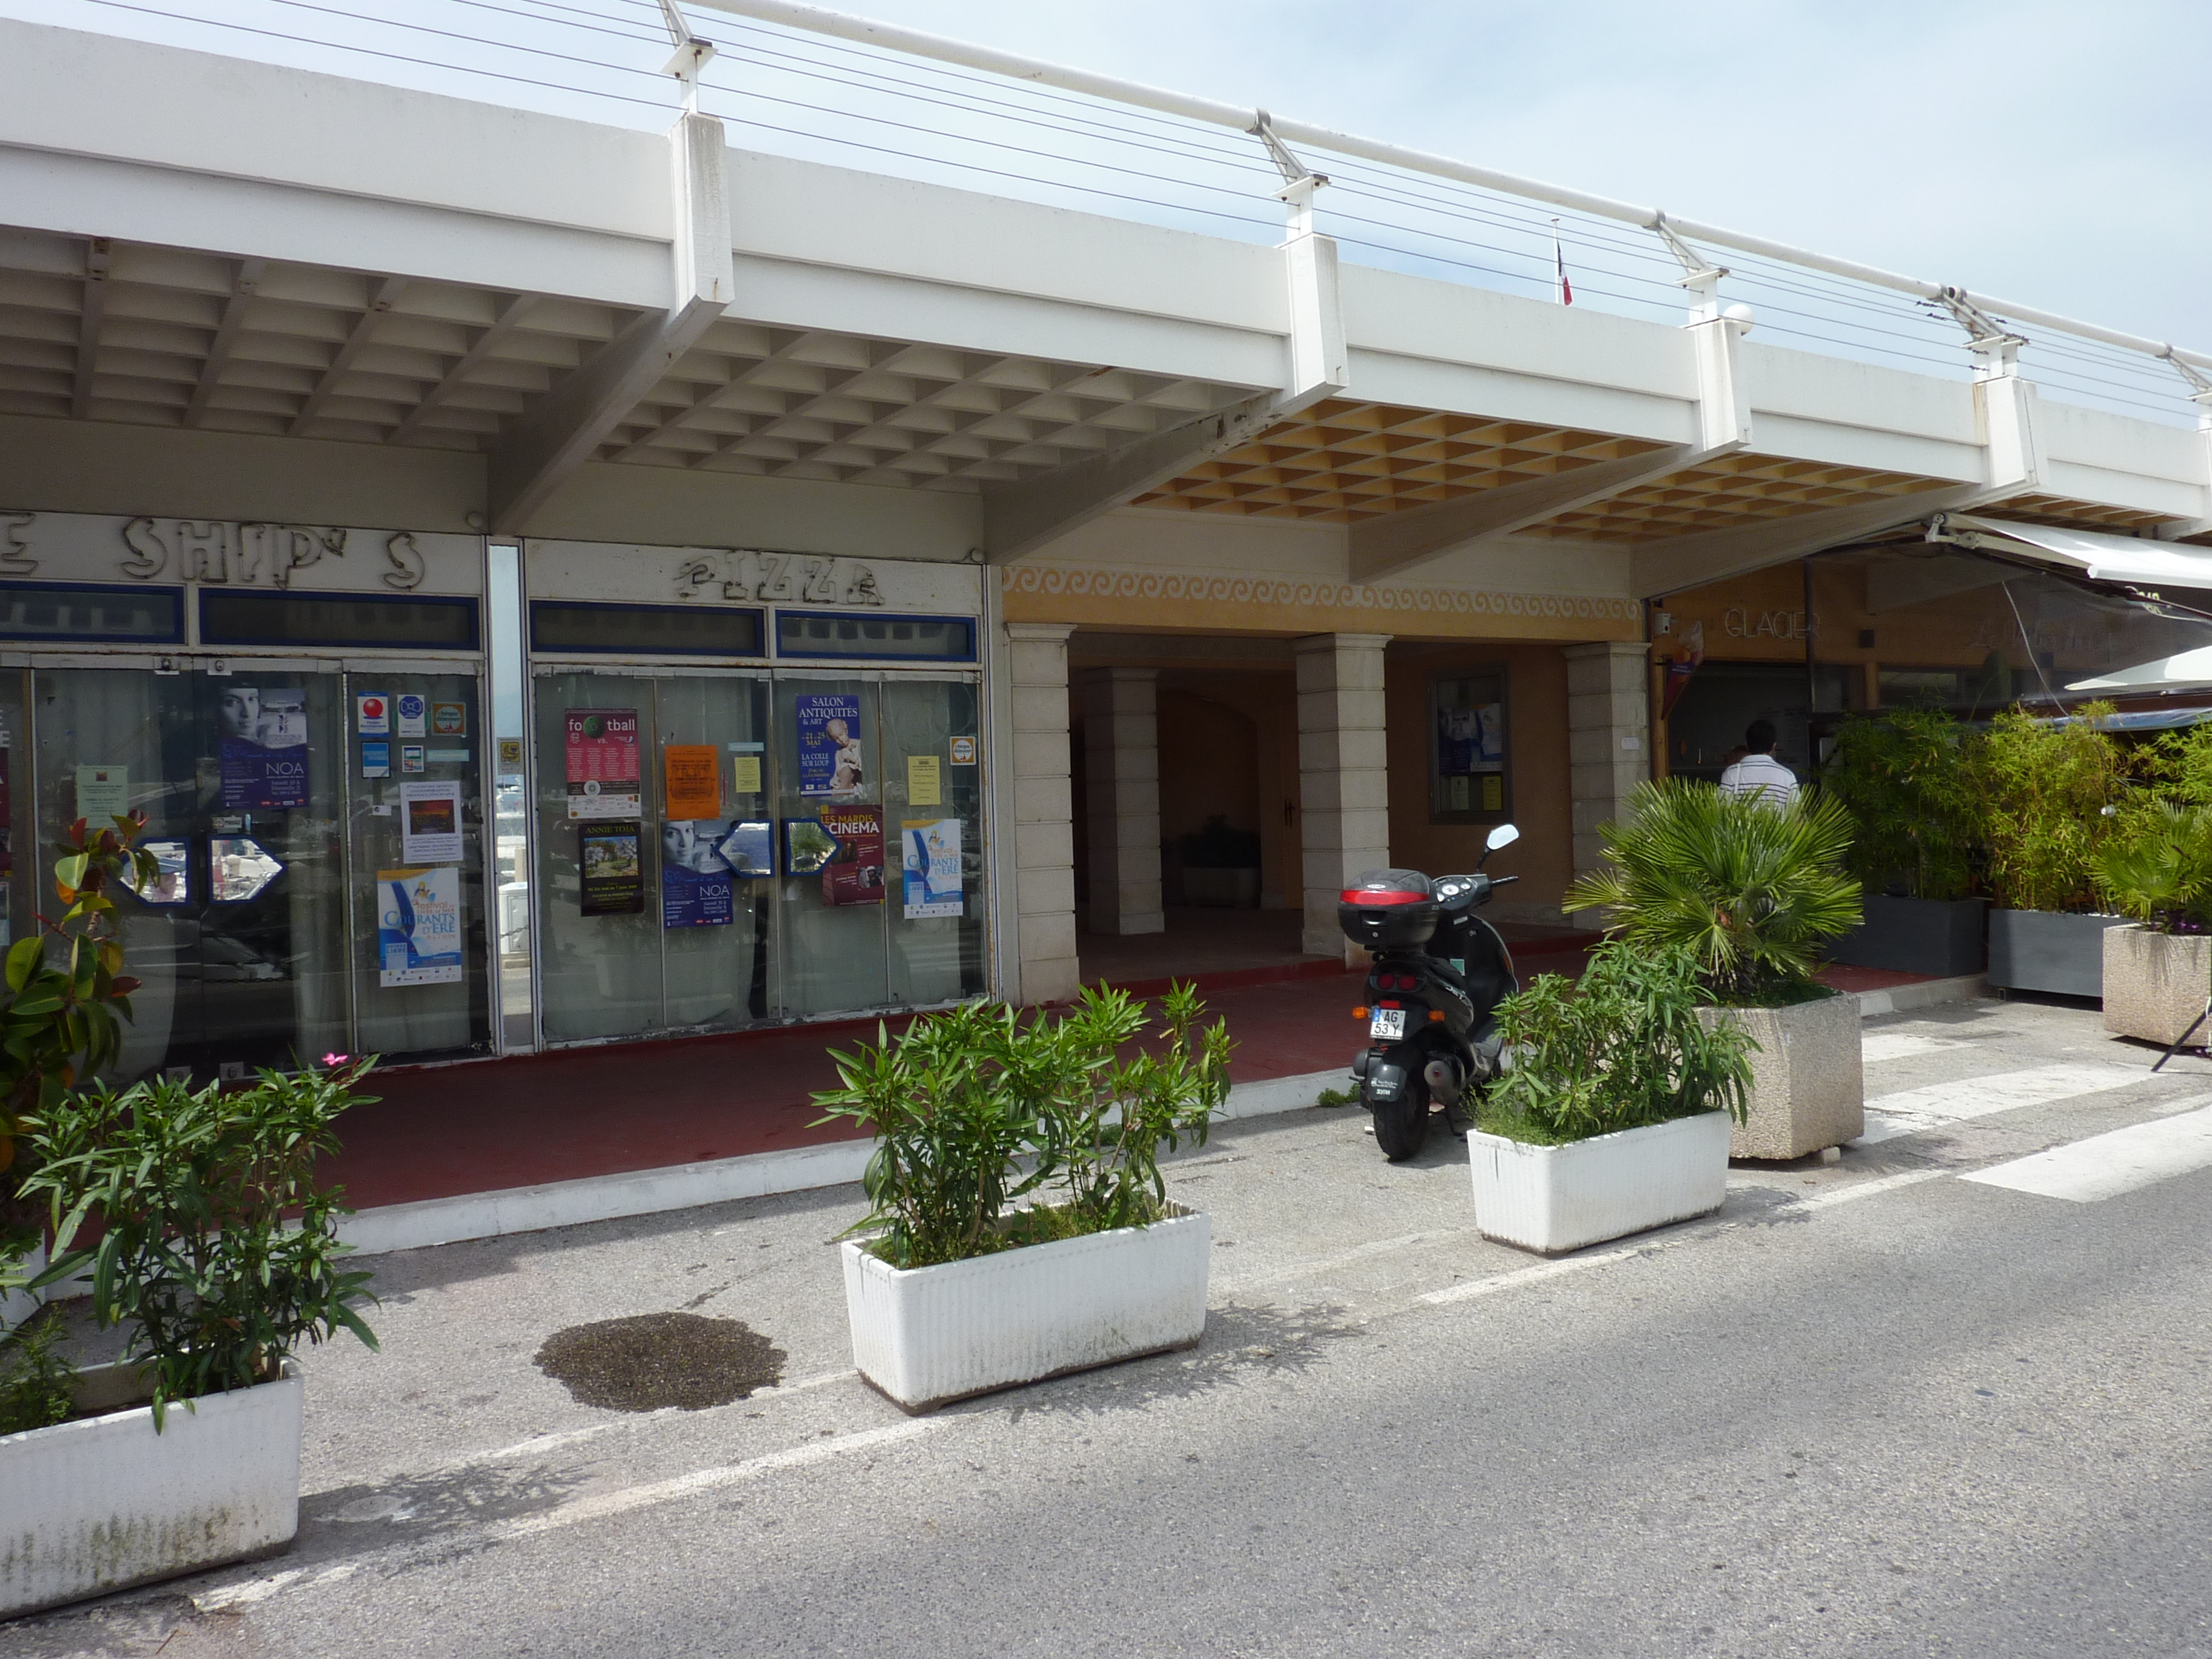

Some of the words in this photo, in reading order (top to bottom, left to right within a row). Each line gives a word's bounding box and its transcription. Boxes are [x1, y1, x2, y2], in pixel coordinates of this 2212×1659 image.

[673, 549, 885, 606] PIZZA
[1725, 608, 1820, 640] GLACIER
[812, 697, 843, 706] SALON
[799, 705, 857, 719] ANTIQUITÉS
[266, 762, 304, 775] NOA
[821, 815, 836, 823] LES
[839, 814, 874, 823] MARDIS
[700, 885, 730, 897] NOA
[1384, 1011, 1398, 1022] AG
[1375, 1024, 1389, 1034] 53
[1393, 1024, 1399, 1035] Y
